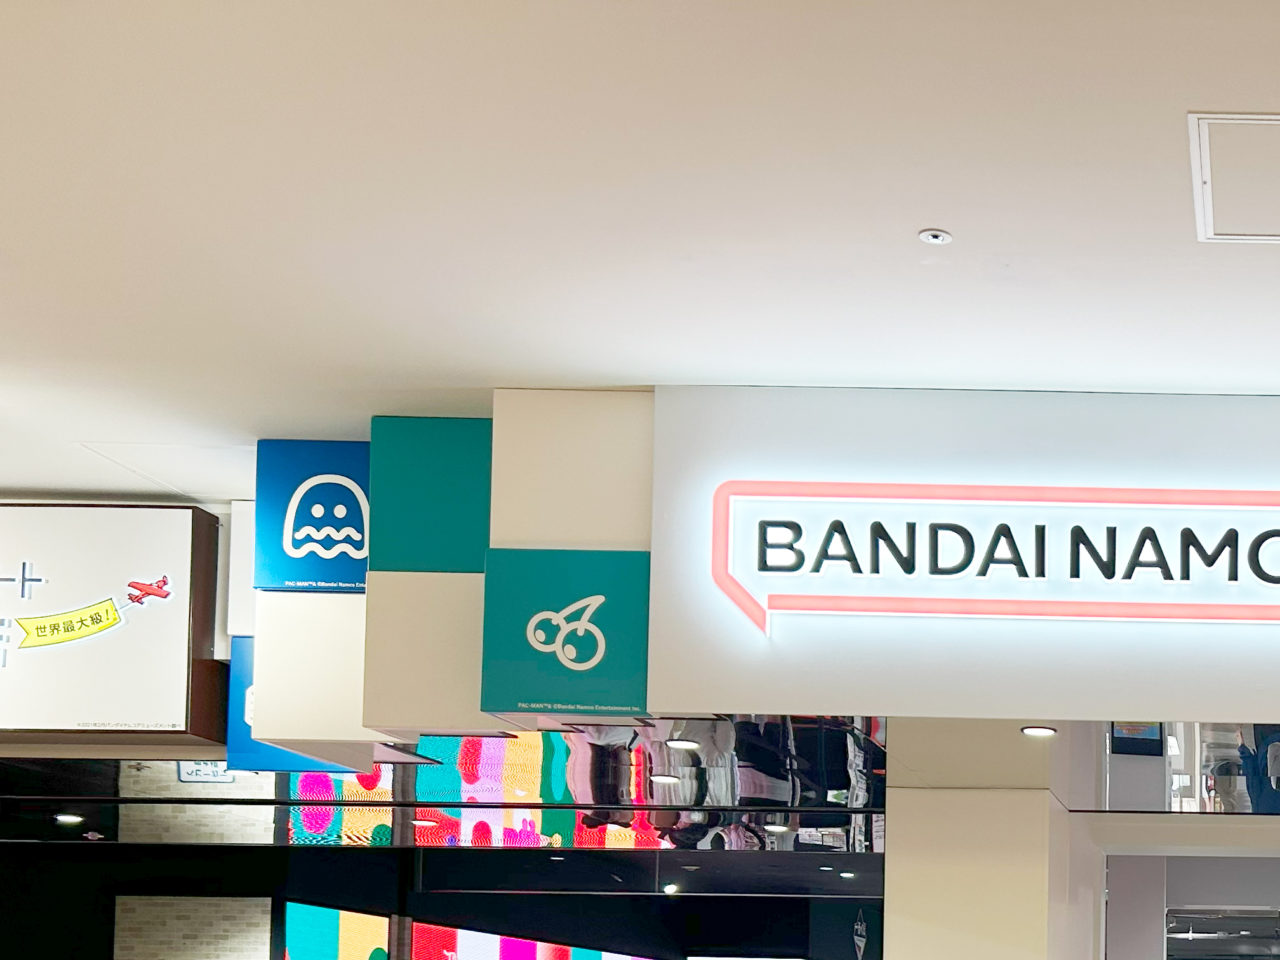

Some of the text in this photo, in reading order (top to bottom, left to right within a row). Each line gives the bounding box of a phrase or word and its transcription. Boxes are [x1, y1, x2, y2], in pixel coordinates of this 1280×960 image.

[757, 519, 1047, 578] BANDAI
[35, 608, 111, 638] 世界最大級!
